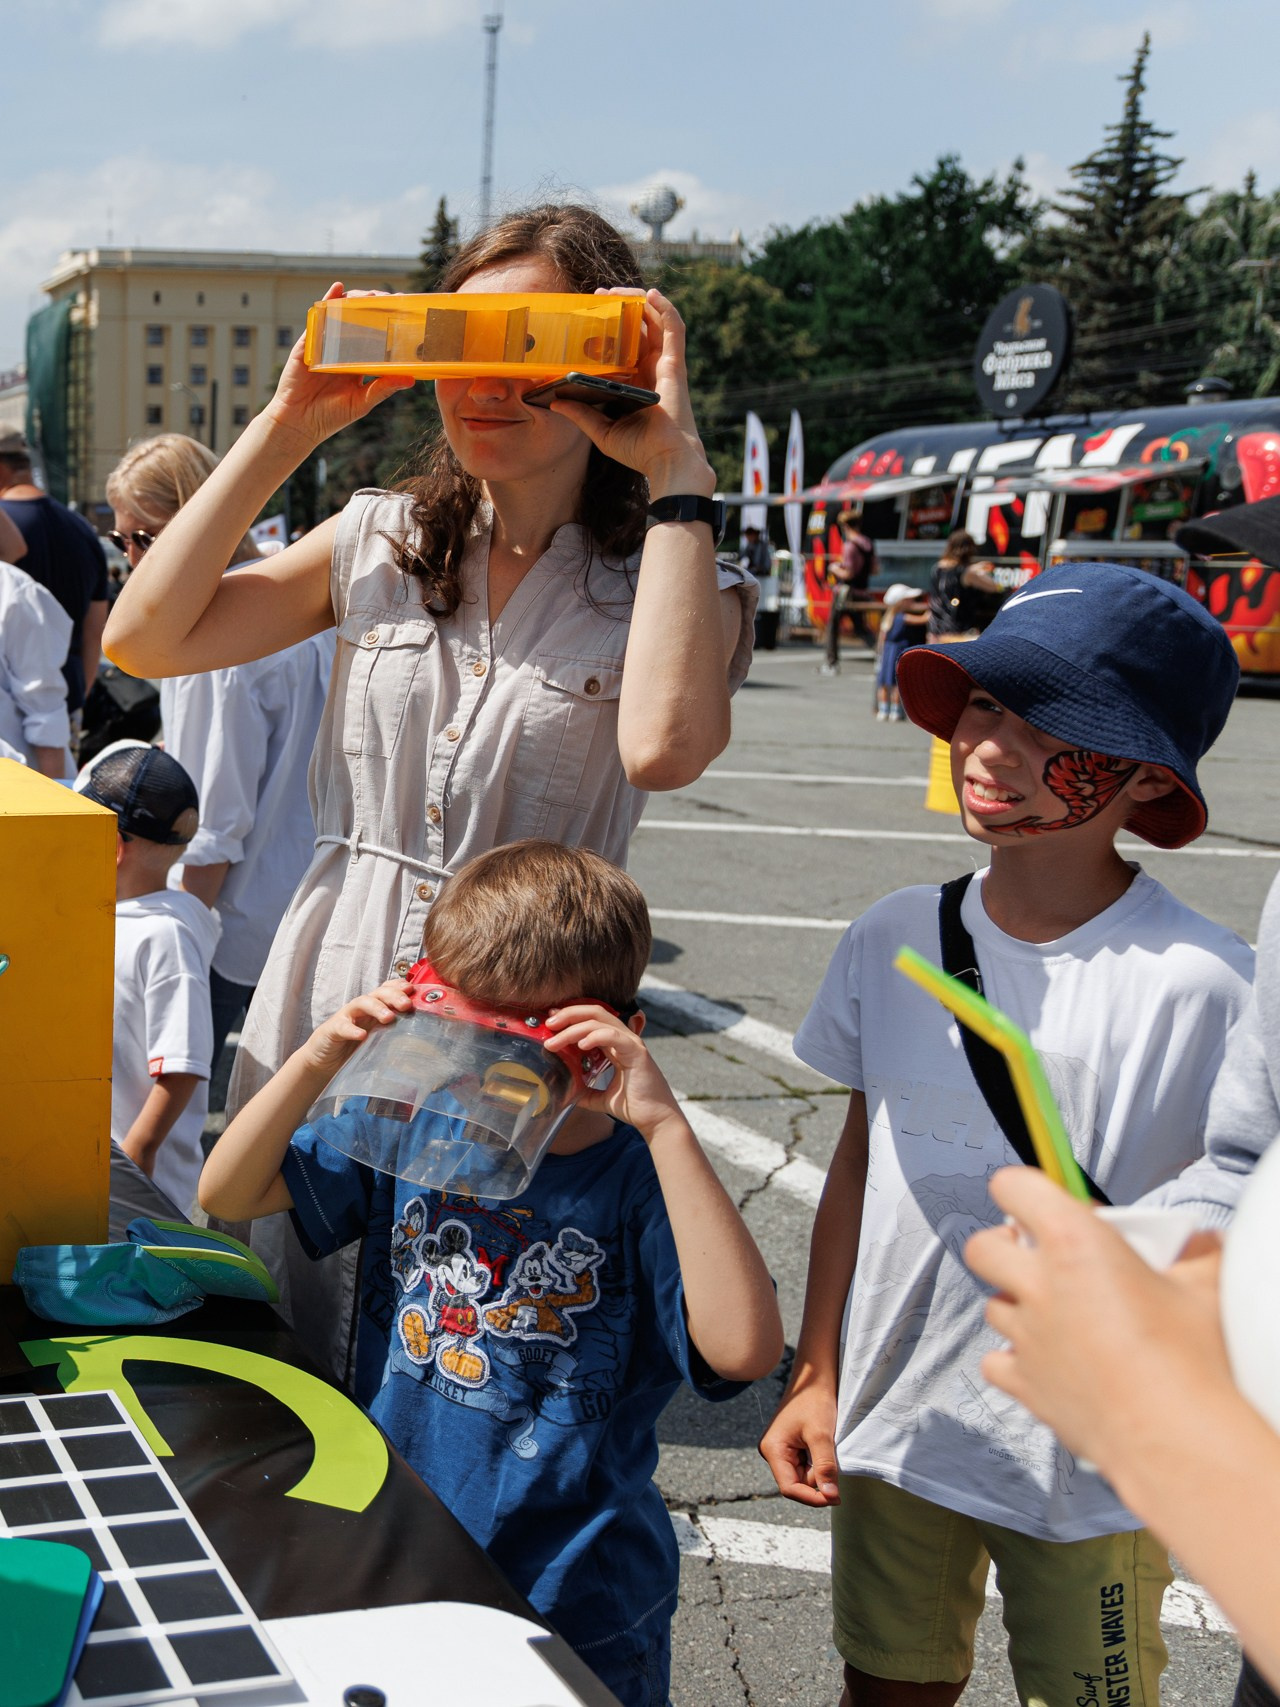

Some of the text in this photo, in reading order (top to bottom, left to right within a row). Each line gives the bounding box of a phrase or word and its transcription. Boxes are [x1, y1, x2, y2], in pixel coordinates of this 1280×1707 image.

[518, 1346, 556, 1364] GOOFY
[424, 1370, 467, 1402] MICKEY
[1100, 1582, 1126, 1648] WAVES
[1073, 1671, 1102, 1707] Surf
